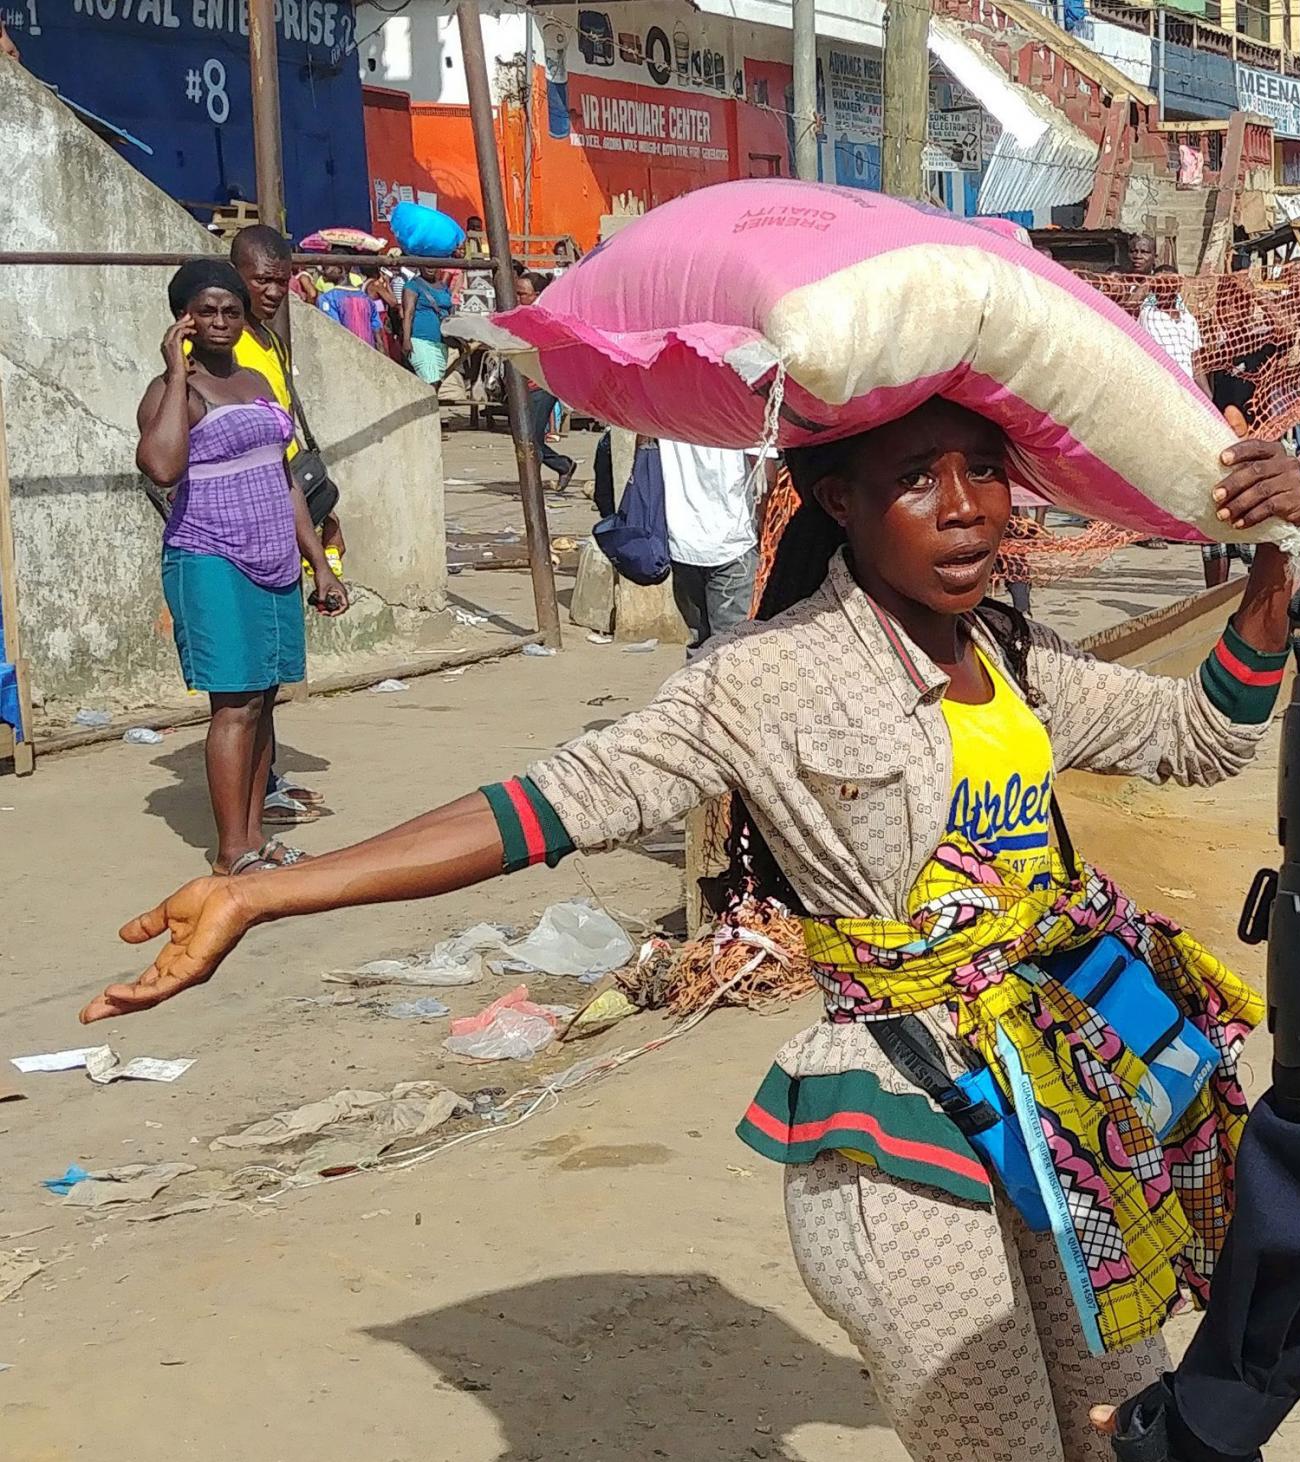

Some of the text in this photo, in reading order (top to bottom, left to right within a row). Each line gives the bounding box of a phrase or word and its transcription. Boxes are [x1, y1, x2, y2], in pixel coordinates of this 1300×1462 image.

[1239, 69, 1300, 104] MEENA
[580, 93, 711, 143] VR HARDWARE CENTER
[732, 216, 831, 234] PREMIER
[739, 206, 837, 221] QUALITY
[1020, 1081, 1042, 1139] GUARANTEED
[1039, 1141, 1051, 1170] SUPER
[1060, 1211, 1073, 1235] HIGH
[1069, 1236, 1086, 1274] QUALITY
